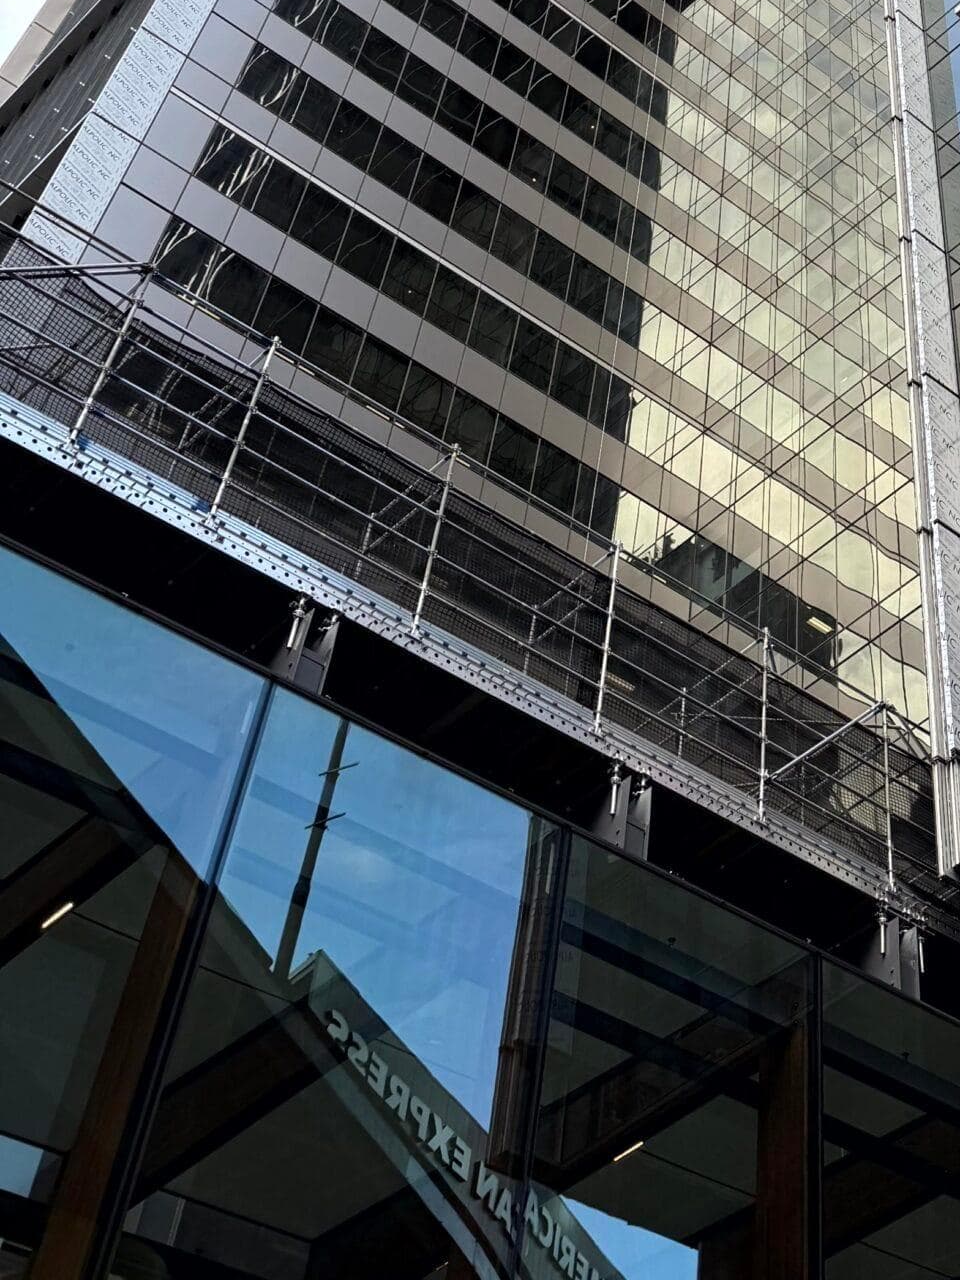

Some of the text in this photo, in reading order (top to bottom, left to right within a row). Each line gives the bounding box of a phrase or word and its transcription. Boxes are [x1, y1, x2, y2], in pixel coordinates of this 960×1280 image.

[138, 99, 148, 108] NC
[128, 116, 138, 126] NC
[84, 126, 120, 161] ALPOLIC NC
[119, 133, 129, 142] NC
[73, 144, 110, 180] ALPOLIC NC
[62, 163, 100, 200] ALPOLIC NC
[50, 182, 89, 220] ALPOLIC NC
[940, 405, 952, 421] NC
[943, 438, 955, 454] NC
[945, 473, 958, 490] NC
